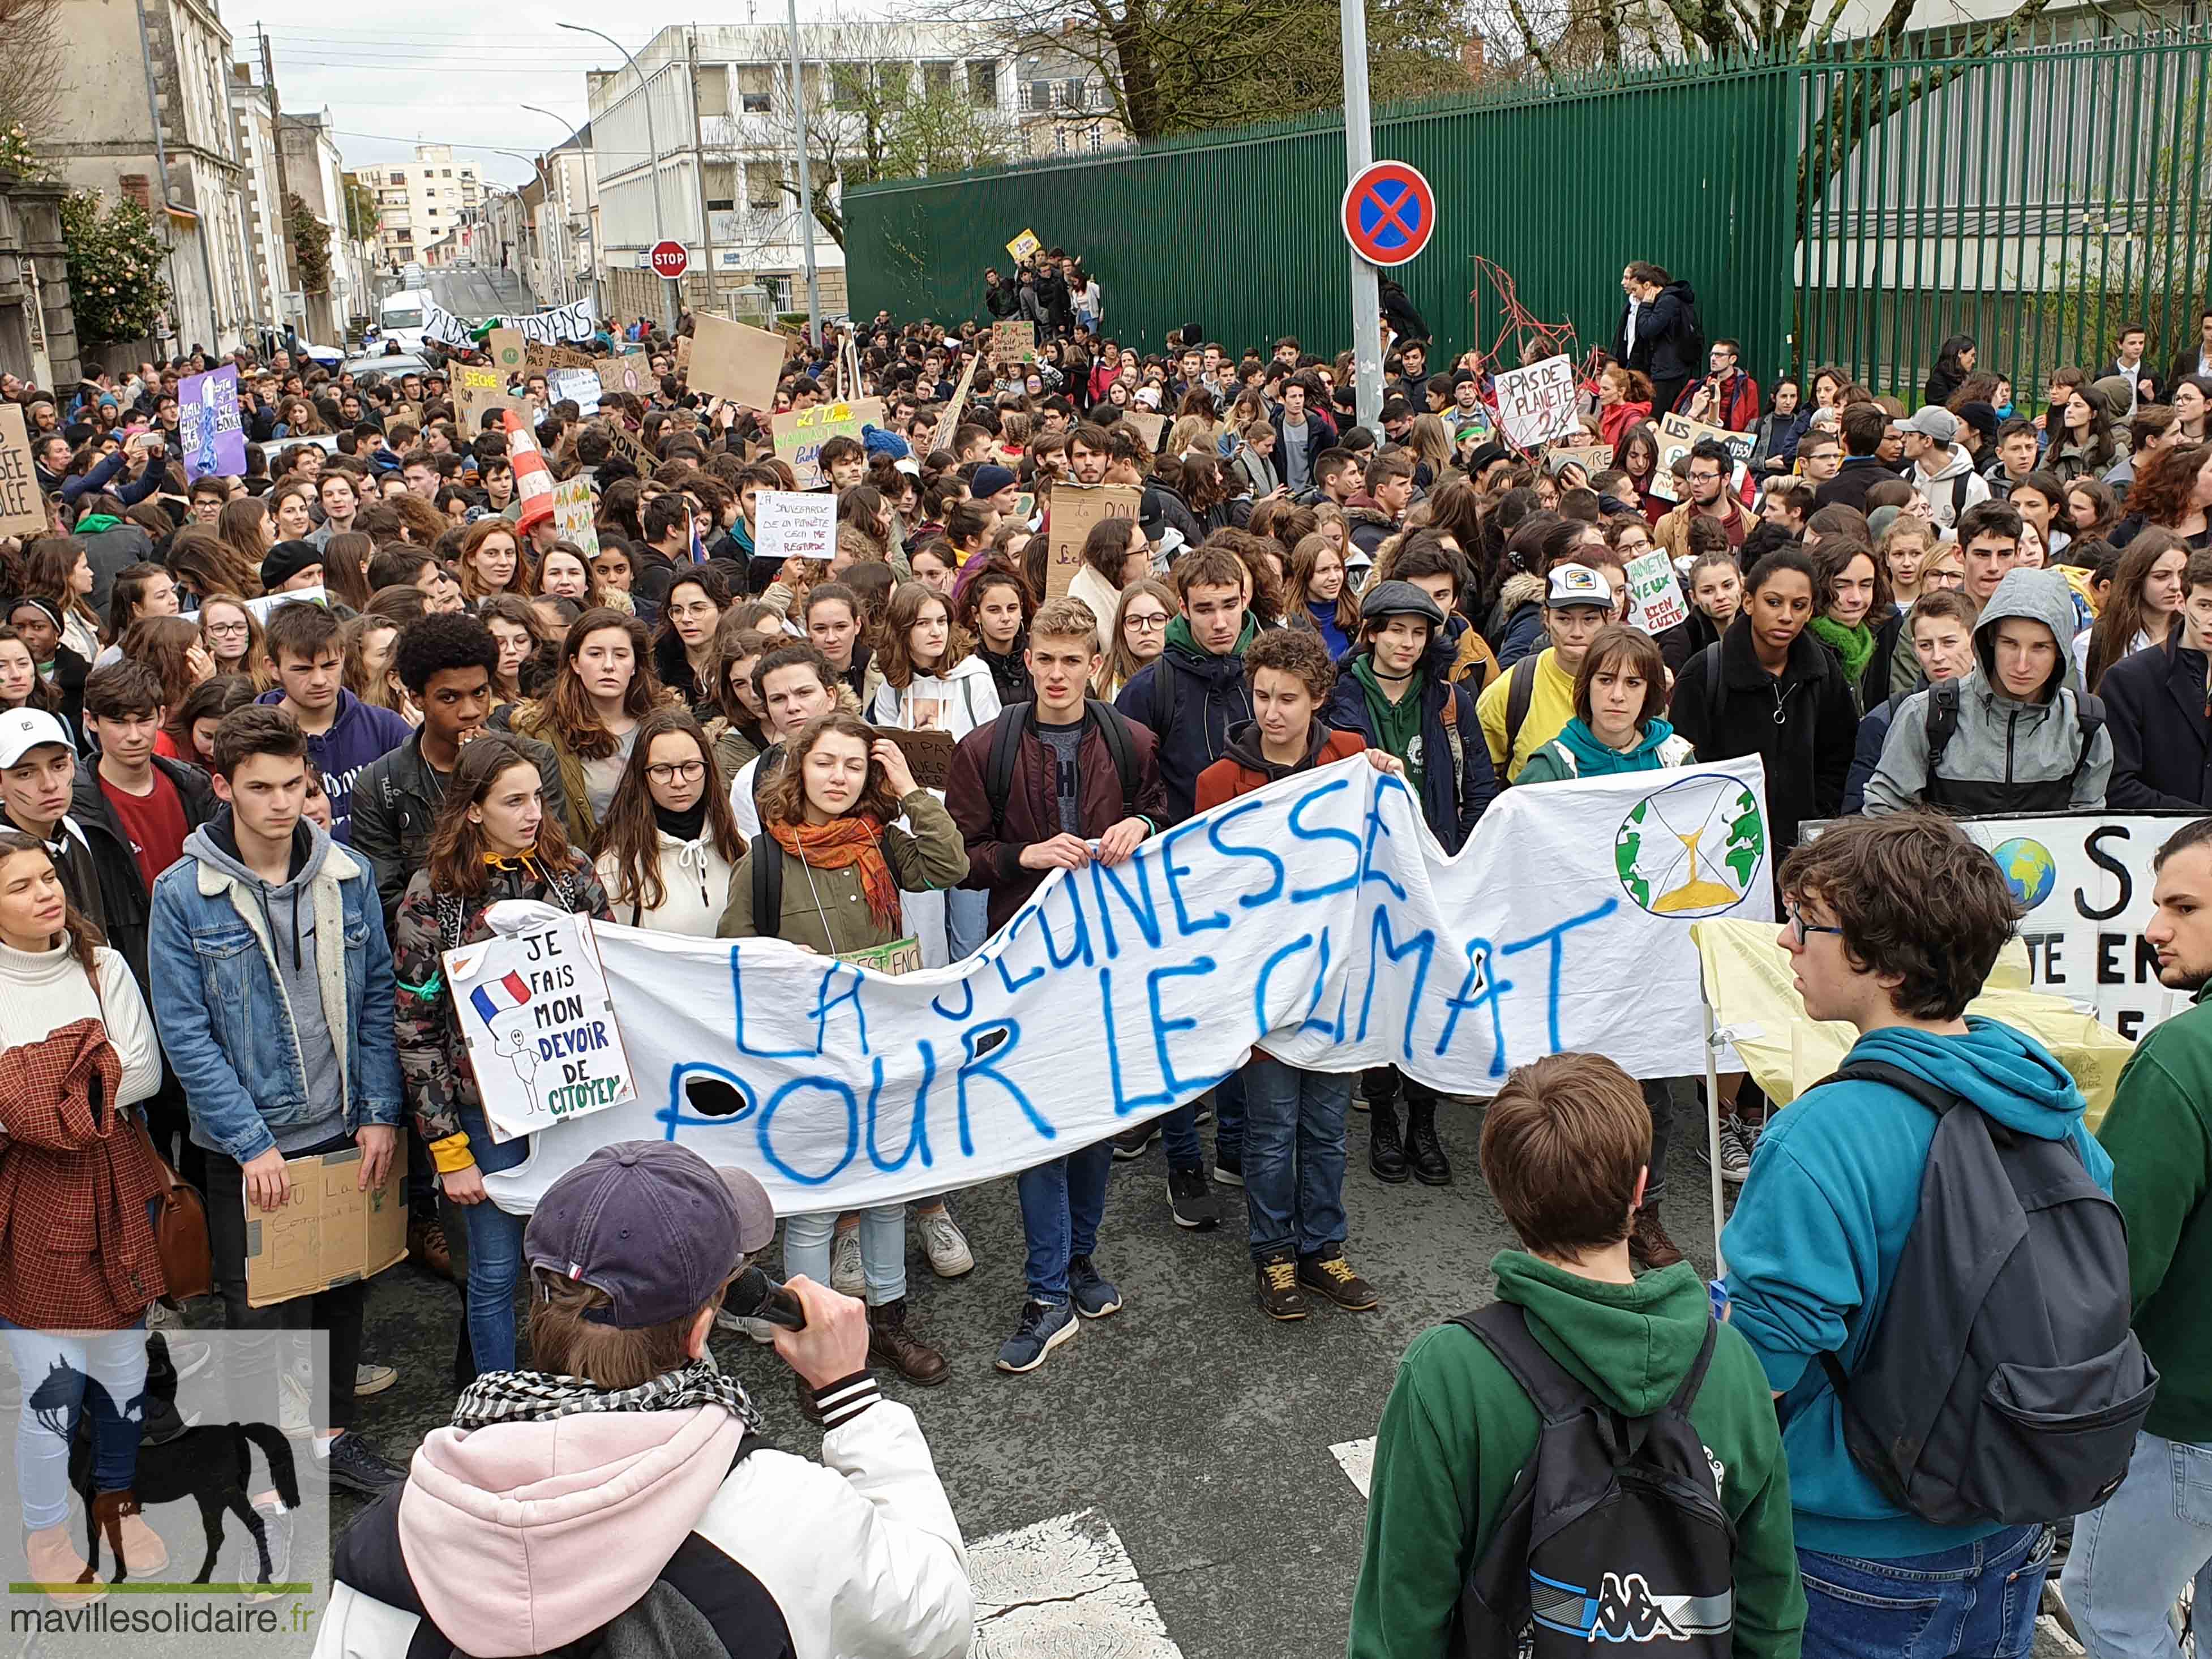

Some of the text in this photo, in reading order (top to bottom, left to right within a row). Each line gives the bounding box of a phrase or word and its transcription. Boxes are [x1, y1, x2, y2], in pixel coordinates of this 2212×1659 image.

[654, 253, 684, 265] STOP
[526, 355, 543, 367] PAS
[529, 344, 594, 368] PAS DE NATURE
[1508, 363, 1562, 397] PAS DE
[1665, 418, 1691, 440] LES
[762, 520, 779, 529] DE
[813, 530, 826, 539] ME
[1644, 595, 1673, 620] BIEN
[1056, 760, 1075, 798] H
[523, 929, 562, 962] JE
[533, 994, 584, 1030] MON
[730, 945, 869, 1059] LA
[562, 1059, 590, 1084] DE
[655, 1017, 1057, 1185] POUR
[1100, 955, 1234, 1117] LE
